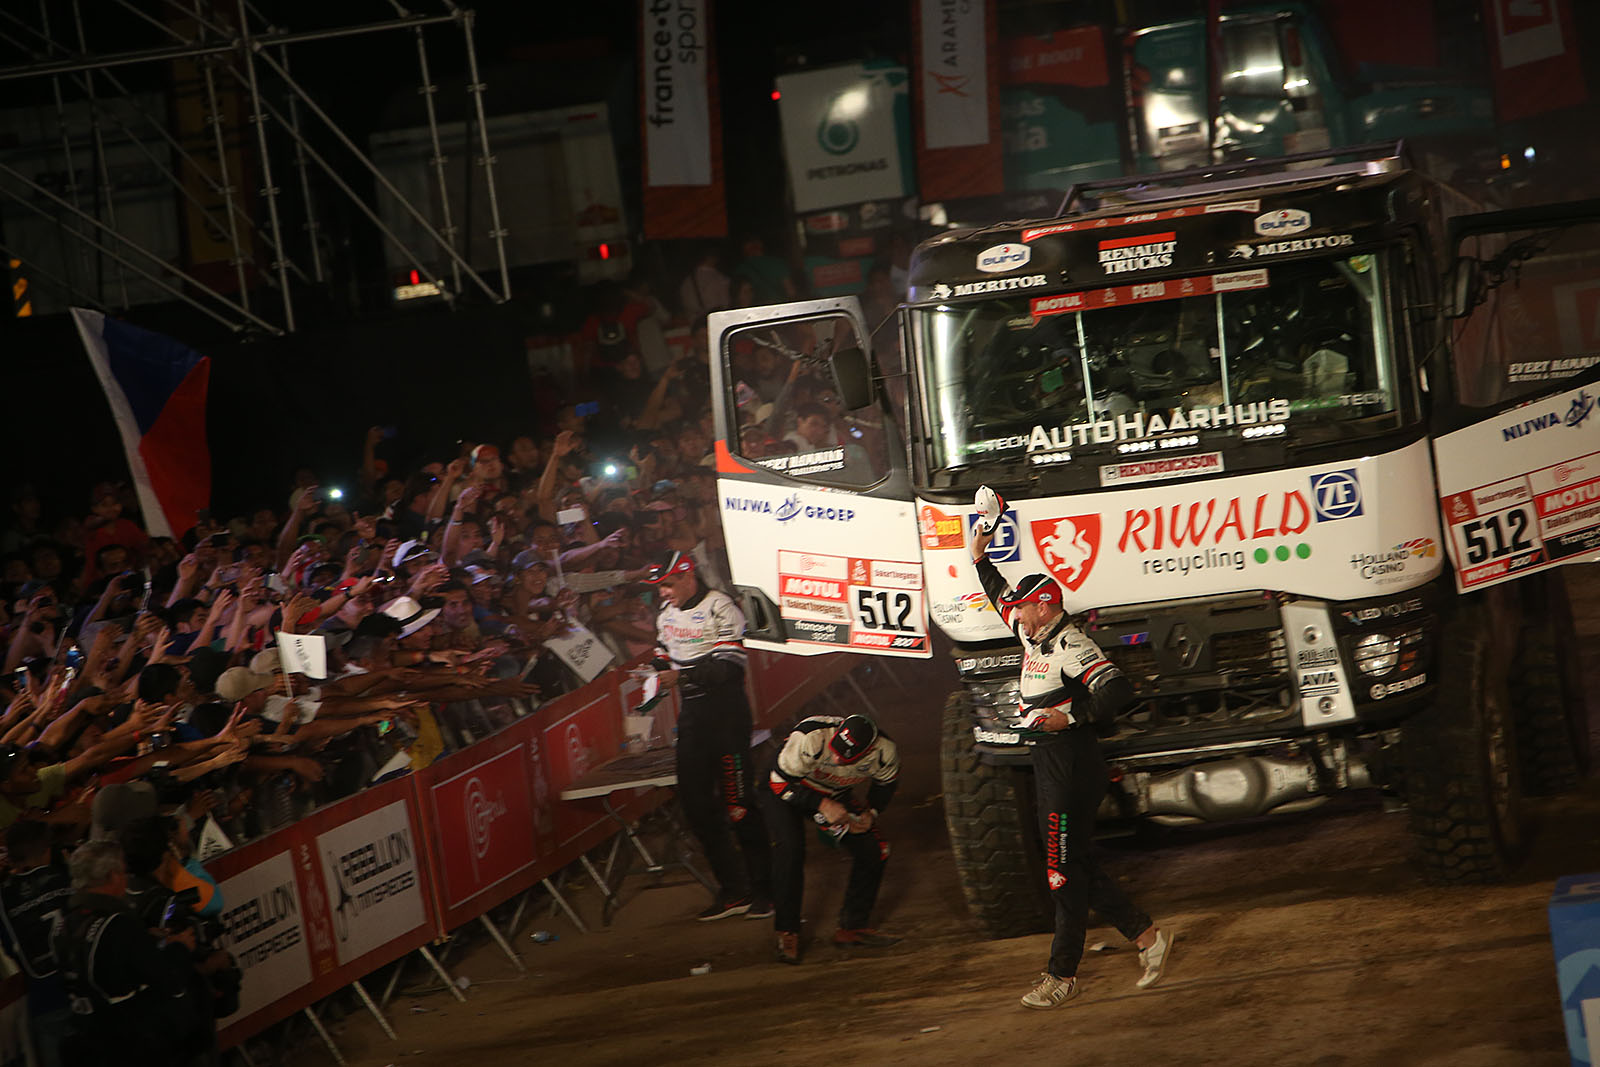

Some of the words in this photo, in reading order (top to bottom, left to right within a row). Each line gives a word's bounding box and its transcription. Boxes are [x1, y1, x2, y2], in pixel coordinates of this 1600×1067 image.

[807, 158, 888, 181] PETRONAS
[1260, 212, 1306, 231] eurol
[1098, 241, 1177, 263] RENAULT
[1256, 234, 1355, 256] MERITOR
[981, 249, 1025, 266] eurol
[1102, 253, 1173, 275] TRUCKS
[952, 274, 1048, 298] MERITOR
[1035, 294, 1083, 313] MOTUL
[1502, 412, 1562, 442] NIJWA
[1119, 453, 1219, 478] HENDRICKSON
[726, 497, 772, 514] NIJWA
[805, 505, 855, 522] GROEP
[1117, 489, 1312, 554] RIWALD
[1463, 508, 1533, 564] 512
[1143, 548, 1246, 576] recycling
[1349, 549, 1410, 569] HOLLAND
[1361, 561, 1405, 579] CASINO
[784, 577, 842, 599] MOTUL
[858, 589, 915, 633] 512
[853, 633, 891, 647] MOTUL
[1300, 669, 1339, 687] AVIA
[1047, 812, 1060, 868] RIWALD
[1059, 832, 1069, 865] recycling
